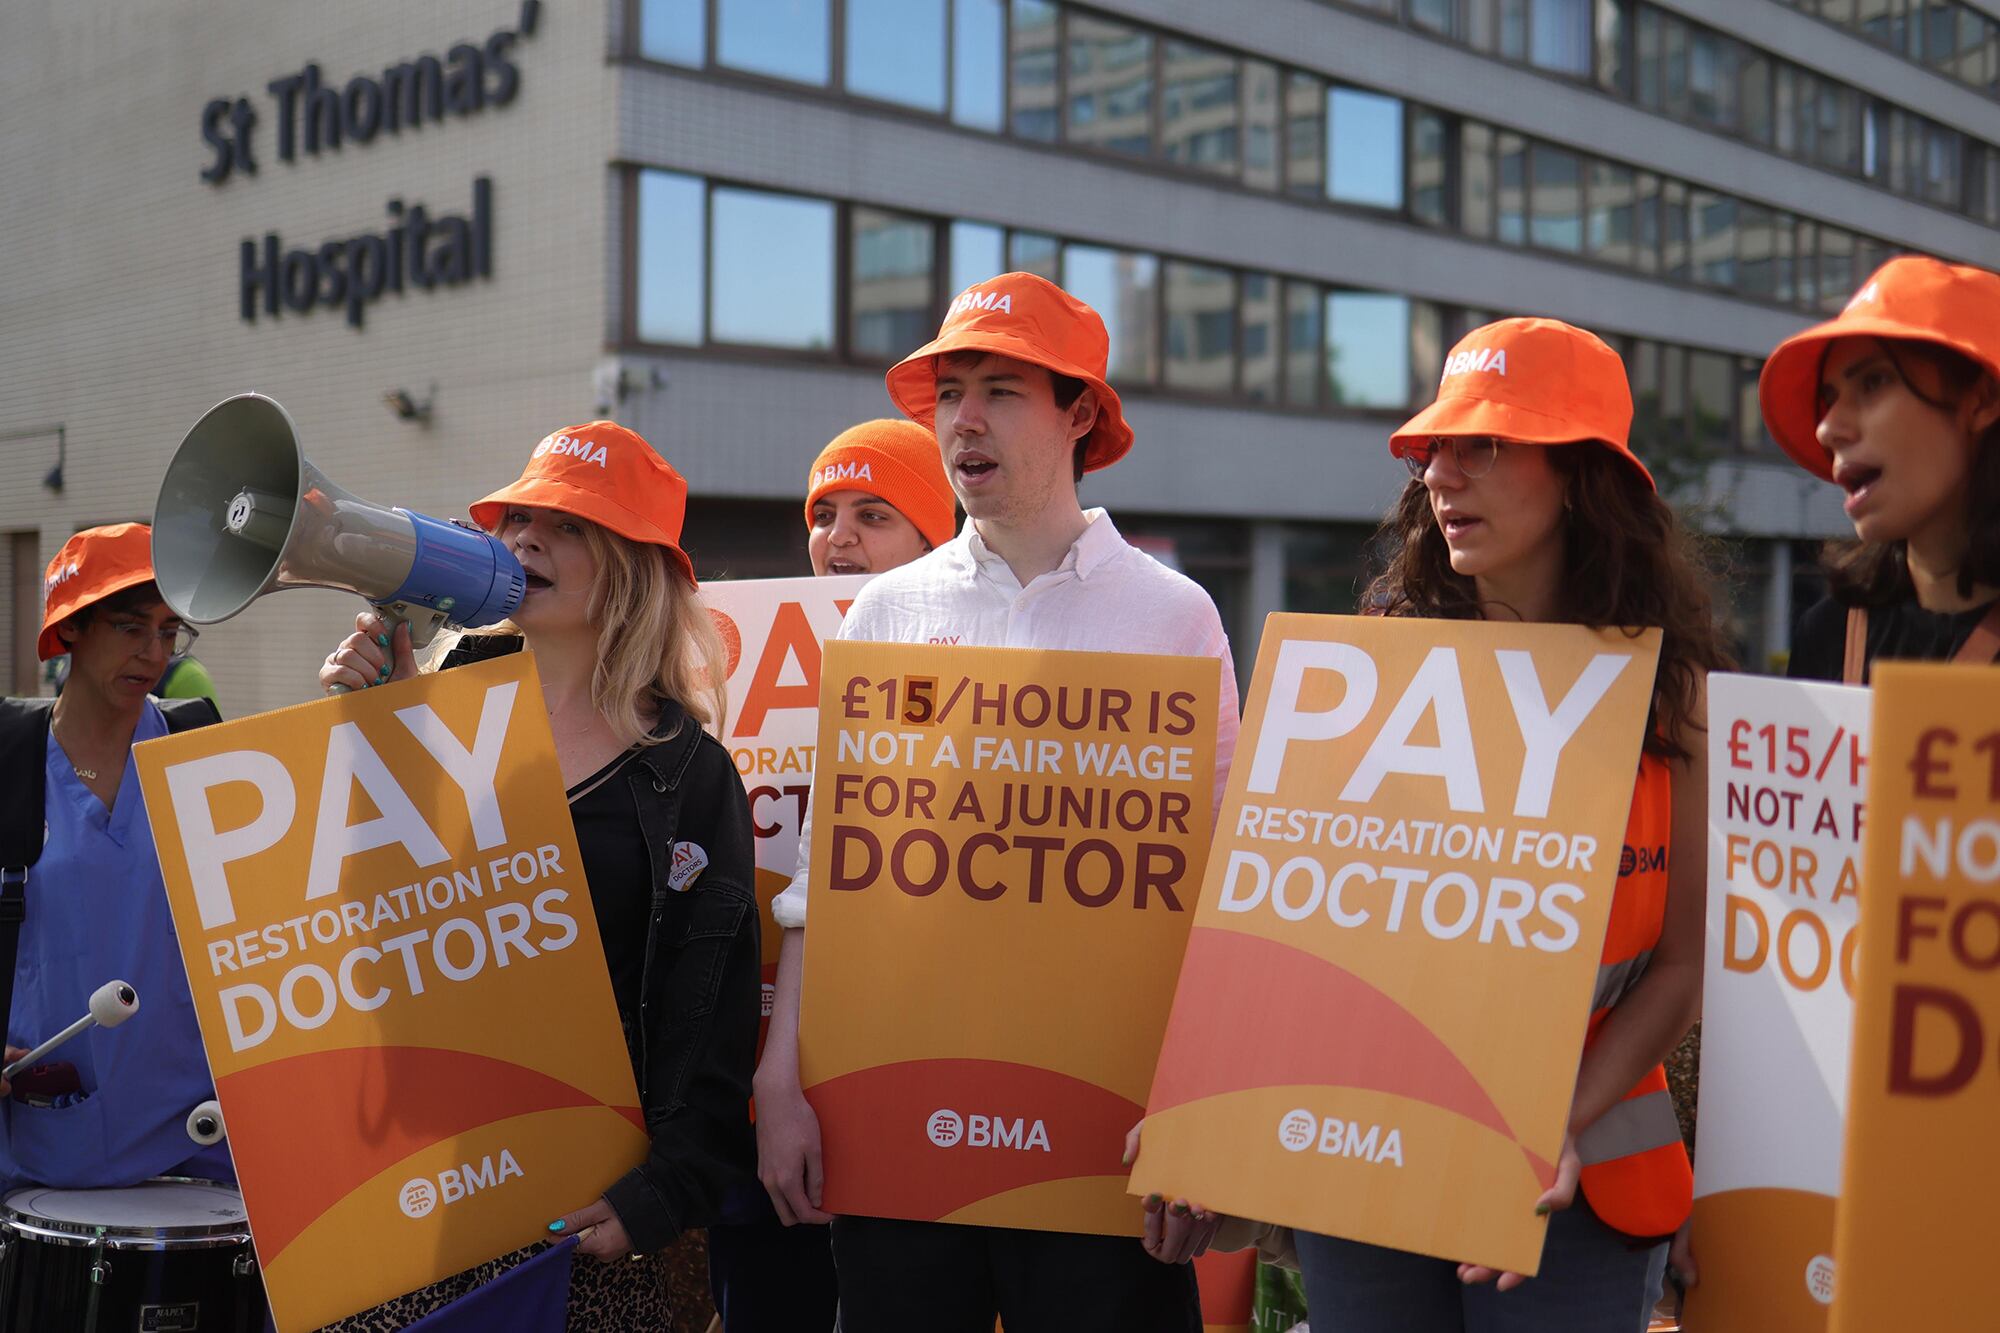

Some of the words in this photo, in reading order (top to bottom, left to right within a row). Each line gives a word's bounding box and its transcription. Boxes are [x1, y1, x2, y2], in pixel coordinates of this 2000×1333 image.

[201, 97, 257, 187] St
[267, 0, 542, 164] Thomas'
[240, 174, 494, 329] Hospital
[957, 291, 1012, 315] BMA
[1449, 347, 1506, 376] BMA
[551, 434, 608, 468] BMA
[823, 462, 873, 482] BMA
[840, 676, 1132, 734] £15/HOUR
[1148, 690, 1196, 735] IS
[1246, 639, 1632, 818] PAY
[836, 730, 924, 768] NOT
[930, 735, 962, 769] A
[972, 737, 1063, 775] FAIR
[1074, 742, 1193, 781] WAGE
[164, 681, 520, 930] PAY
[834, 774, 937, 821] FOR
[948, 781, 986, 823] A
[993, 784, 1191, 834] JUNIOR
[1727, 781, 1804, 831] NOT
[1812, 797, 1840, 841] A
[828, 824, 1187, 912] DOCTOR
[1236, 804, 1506, 864] RESTORATION
[1512, 827, 1597, 873] FOR
[1726, 833, 1818, 900] FOR
[672, 859, 703, 882] DOCTORS
[207, 860, 482, 977] RESTORATION
[491, 844, 565, 896] FOR
[1217, 849, 1586, 954] DOCTORS
[218, 888, 579, 1053] DOCTORS
[966, 1114, 1052, 1152] BMA
[1317, 1118, 1405, 1167] BMA
[438, 1149, 525, 1205] BMA
